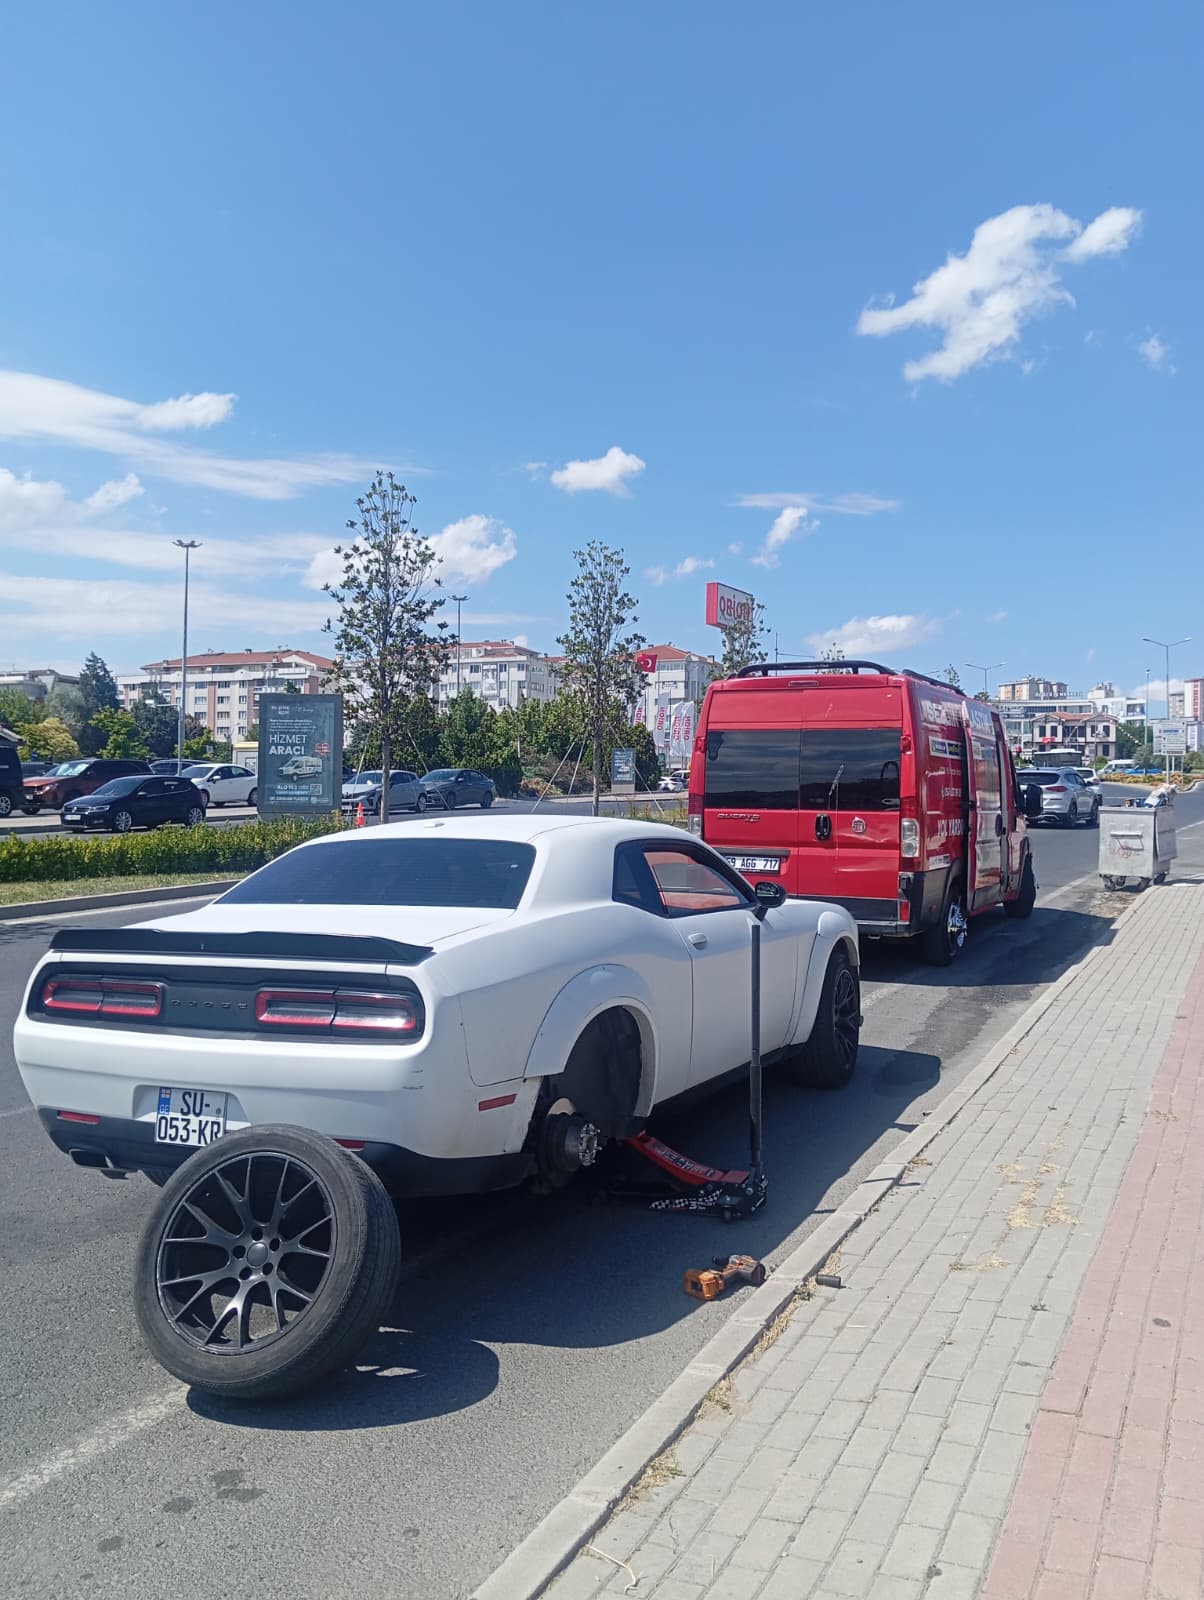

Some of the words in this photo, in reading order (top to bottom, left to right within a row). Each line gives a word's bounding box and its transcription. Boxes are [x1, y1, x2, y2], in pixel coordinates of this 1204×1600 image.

[269, 732, 308, 744] HİZMET
[269, 746, 305, 755] ARACI
[763, 858, 778, 869] 717
[159, 1104, 169, 1115] GE
[180, 1091, 211, 1117] SU-
[157, 1116, 221, 1145] 053-KR
